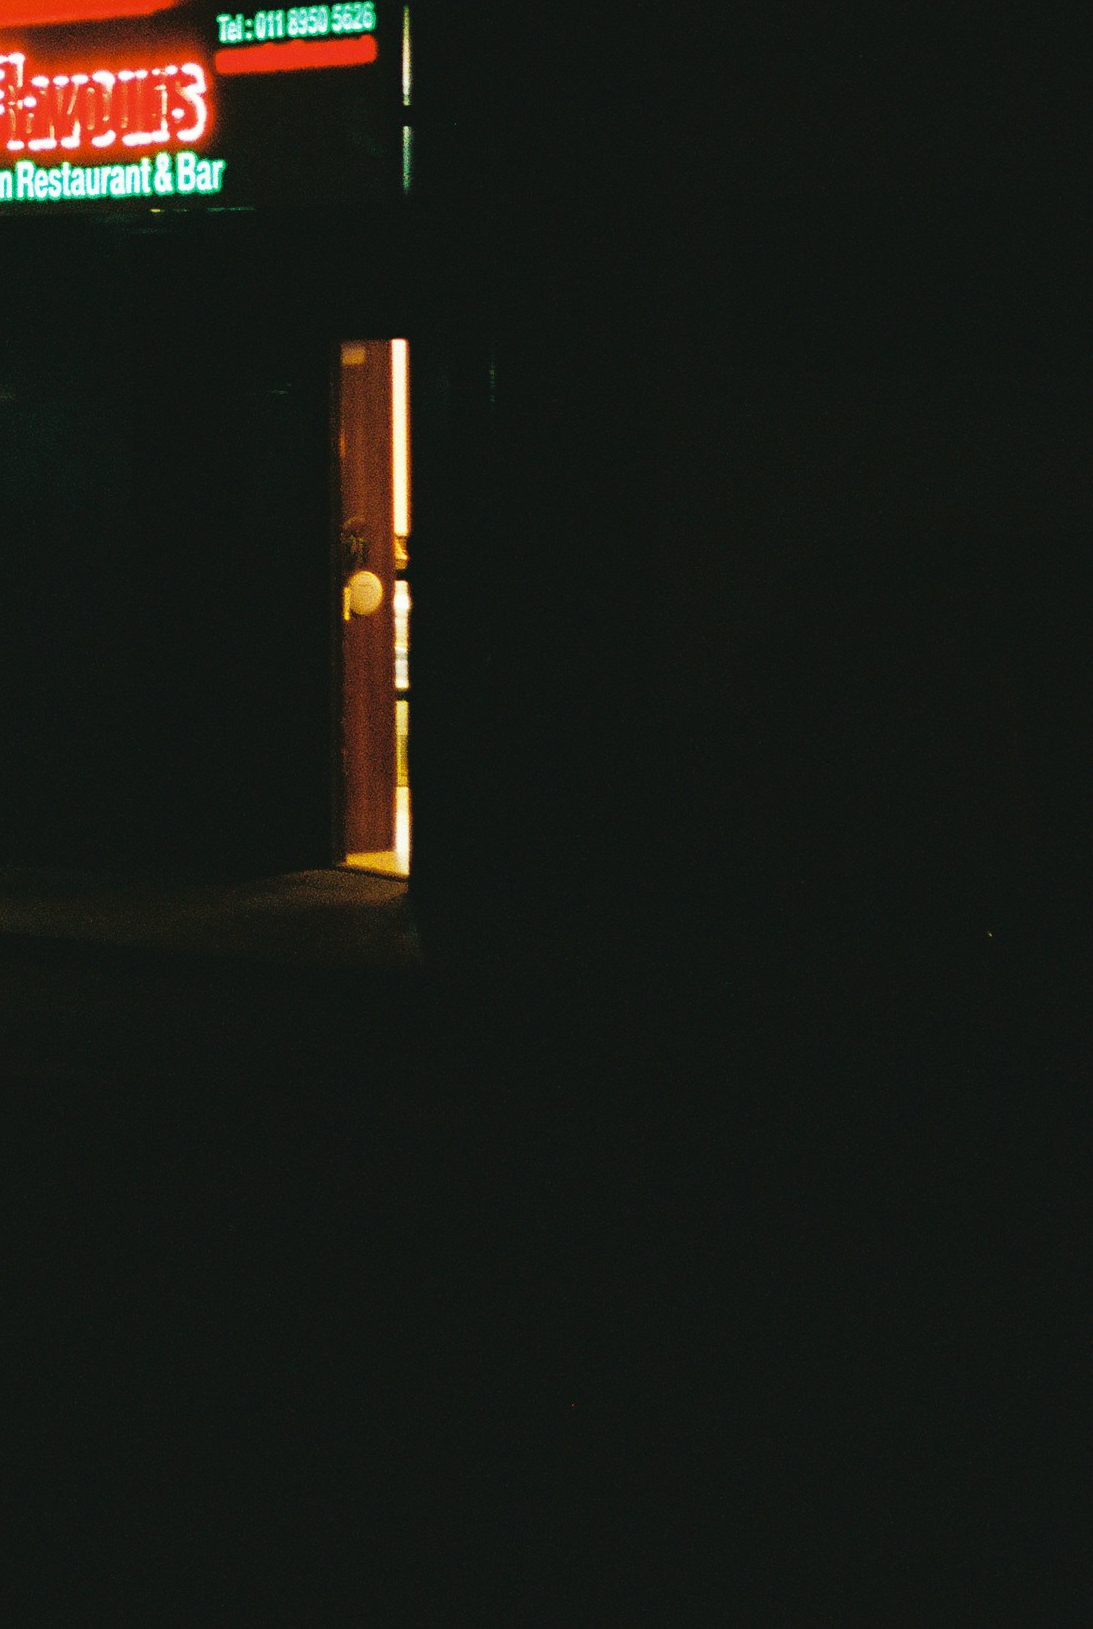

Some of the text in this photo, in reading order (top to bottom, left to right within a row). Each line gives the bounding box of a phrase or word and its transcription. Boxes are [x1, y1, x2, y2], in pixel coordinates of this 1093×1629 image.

[255, 10, 285, 40] 011
[287, 4, 330, 37] 8950
[15, 159, 152, 201] Restaurant
[154, 151, 174, 193] &
[176, 151, 225, 193] Bar
